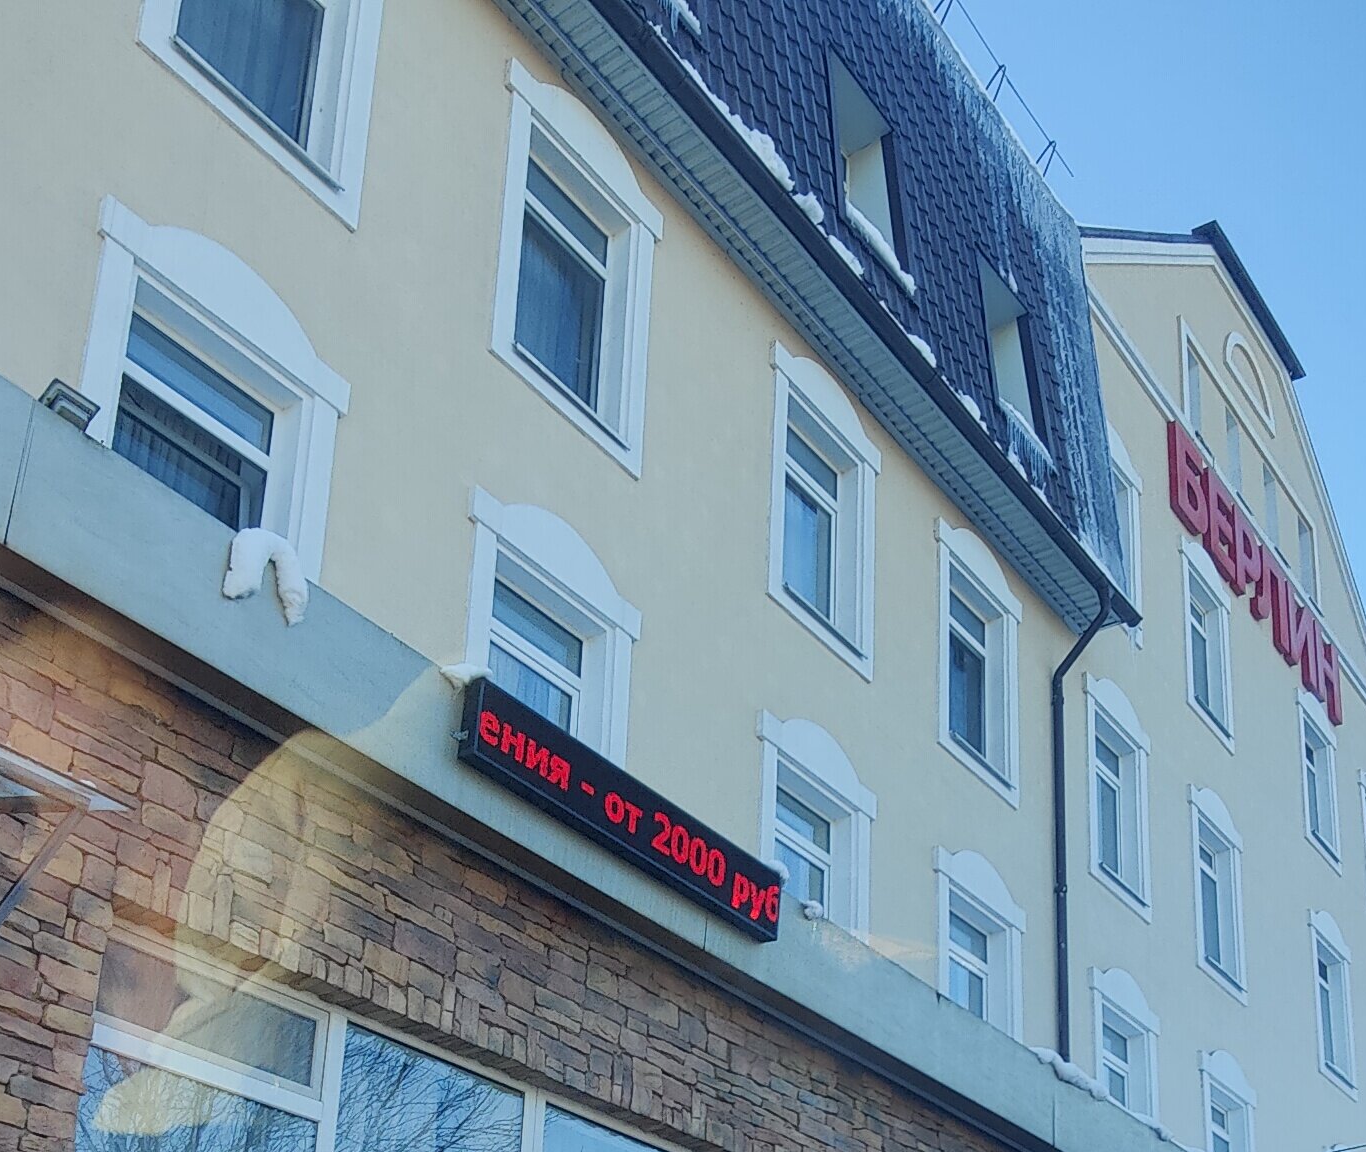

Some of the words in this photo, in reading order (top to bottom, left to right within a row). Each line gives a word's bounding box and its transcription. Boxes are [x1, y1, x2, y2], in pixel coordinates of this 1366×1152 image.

[1167, 420, 1343, 726] БЕРЛИН
[479, 710, 572, 791] ения
[603, 792, 643, 834] от
[651, 812, 726, 887] 2000
[731, 872, 779, 923] руб
